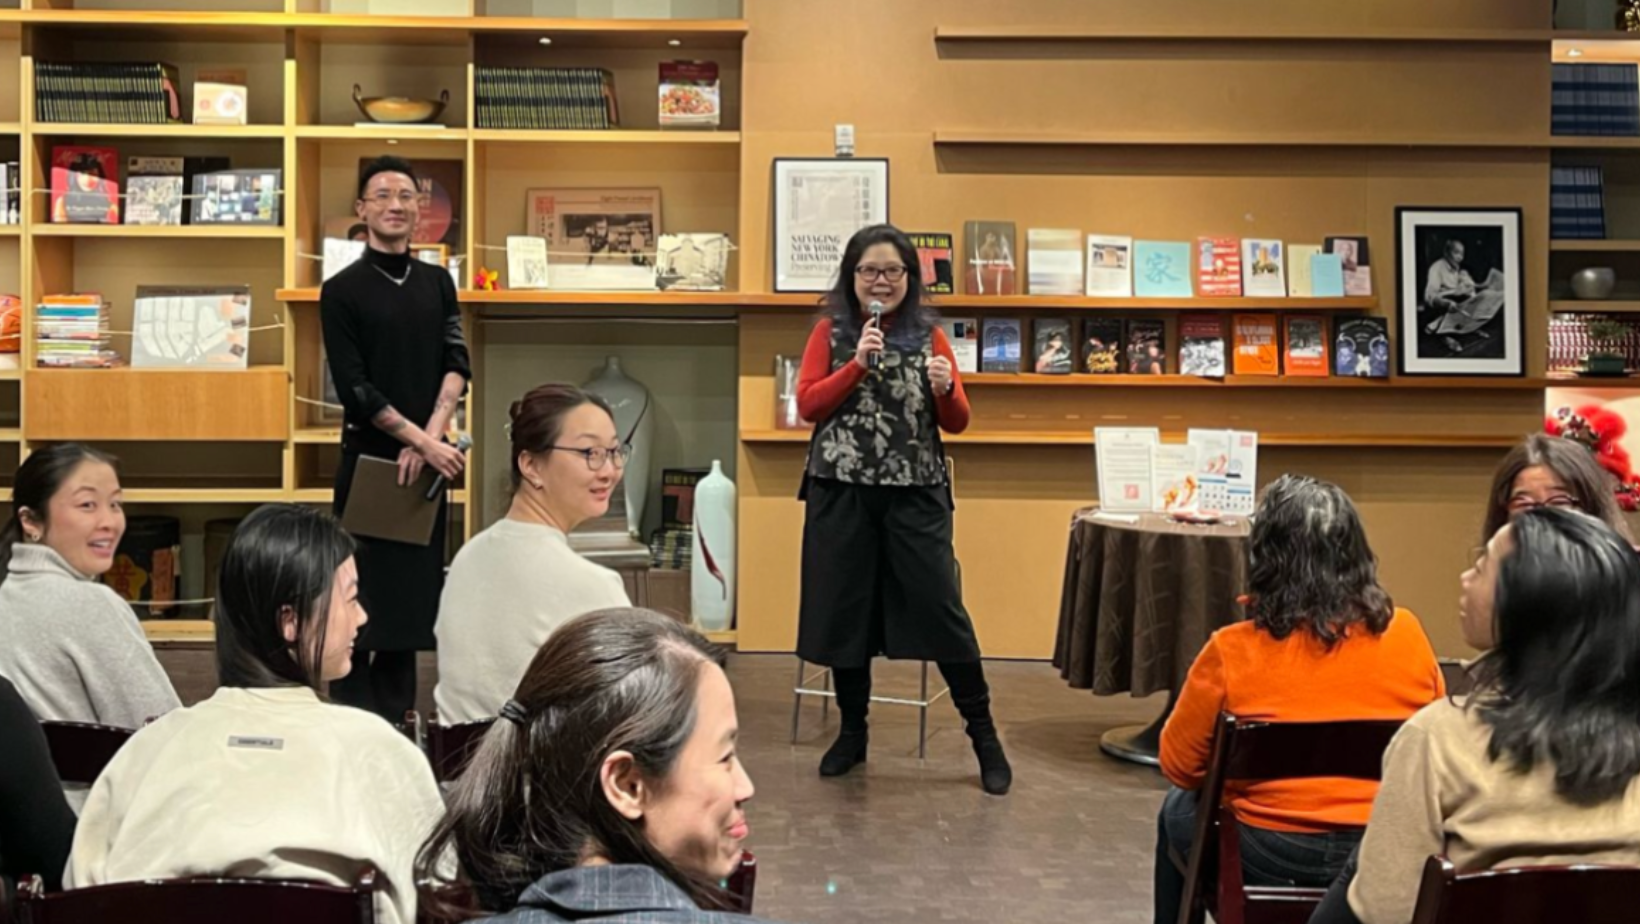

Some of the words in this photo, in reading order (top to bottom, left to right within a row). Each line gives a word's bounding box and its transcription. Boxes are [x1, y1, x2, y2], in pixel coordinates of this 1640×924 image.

[791, 234, 840, 244] SALVAGING
[791, 243, 811, 252] NEW
[813, 243, 838, 253] YORK
[791, 262, 832, 273] Preserving
